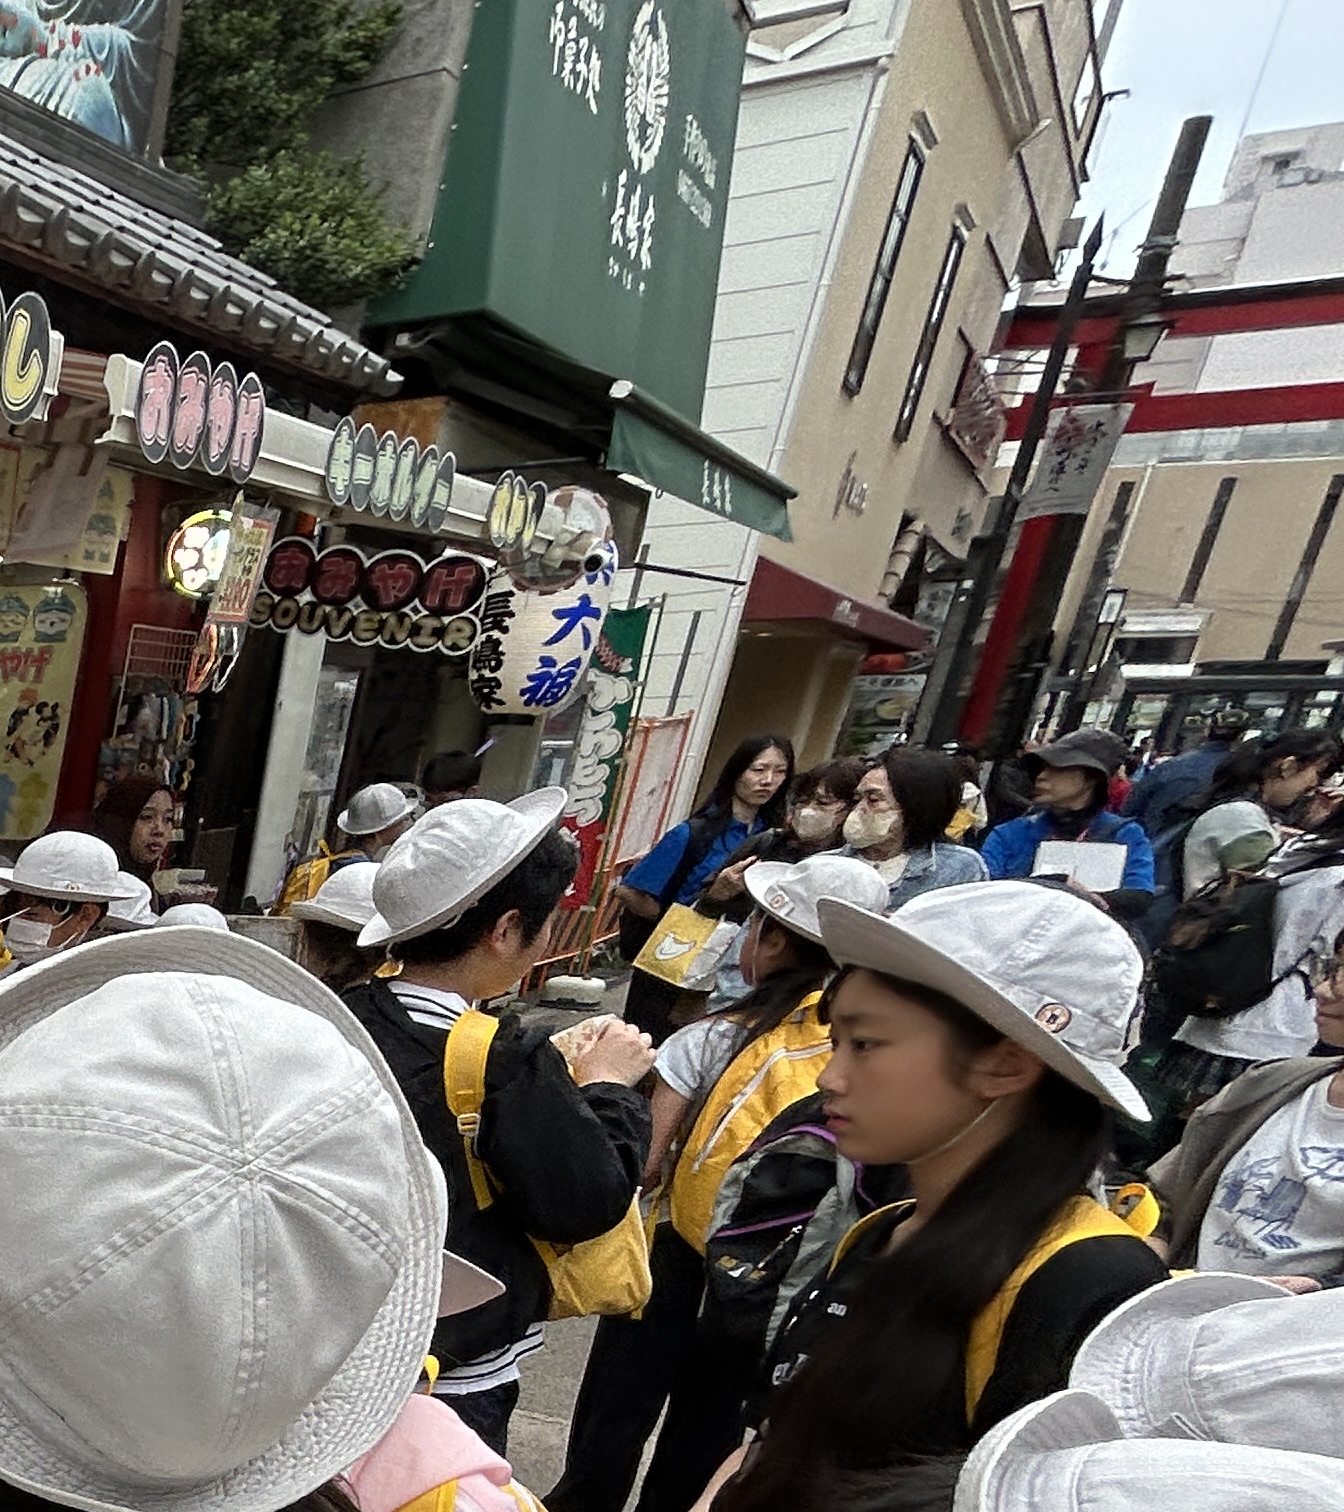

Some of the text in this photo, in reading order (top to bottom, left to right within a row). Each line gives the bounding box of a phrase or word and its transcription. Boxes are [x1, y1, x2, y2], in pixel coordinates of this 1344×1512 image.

[142, 354, 261, 473] おみやげ
[273, 547, 476, 606] おみやげ
[256, 597, 475, 648] SOUVENIR
